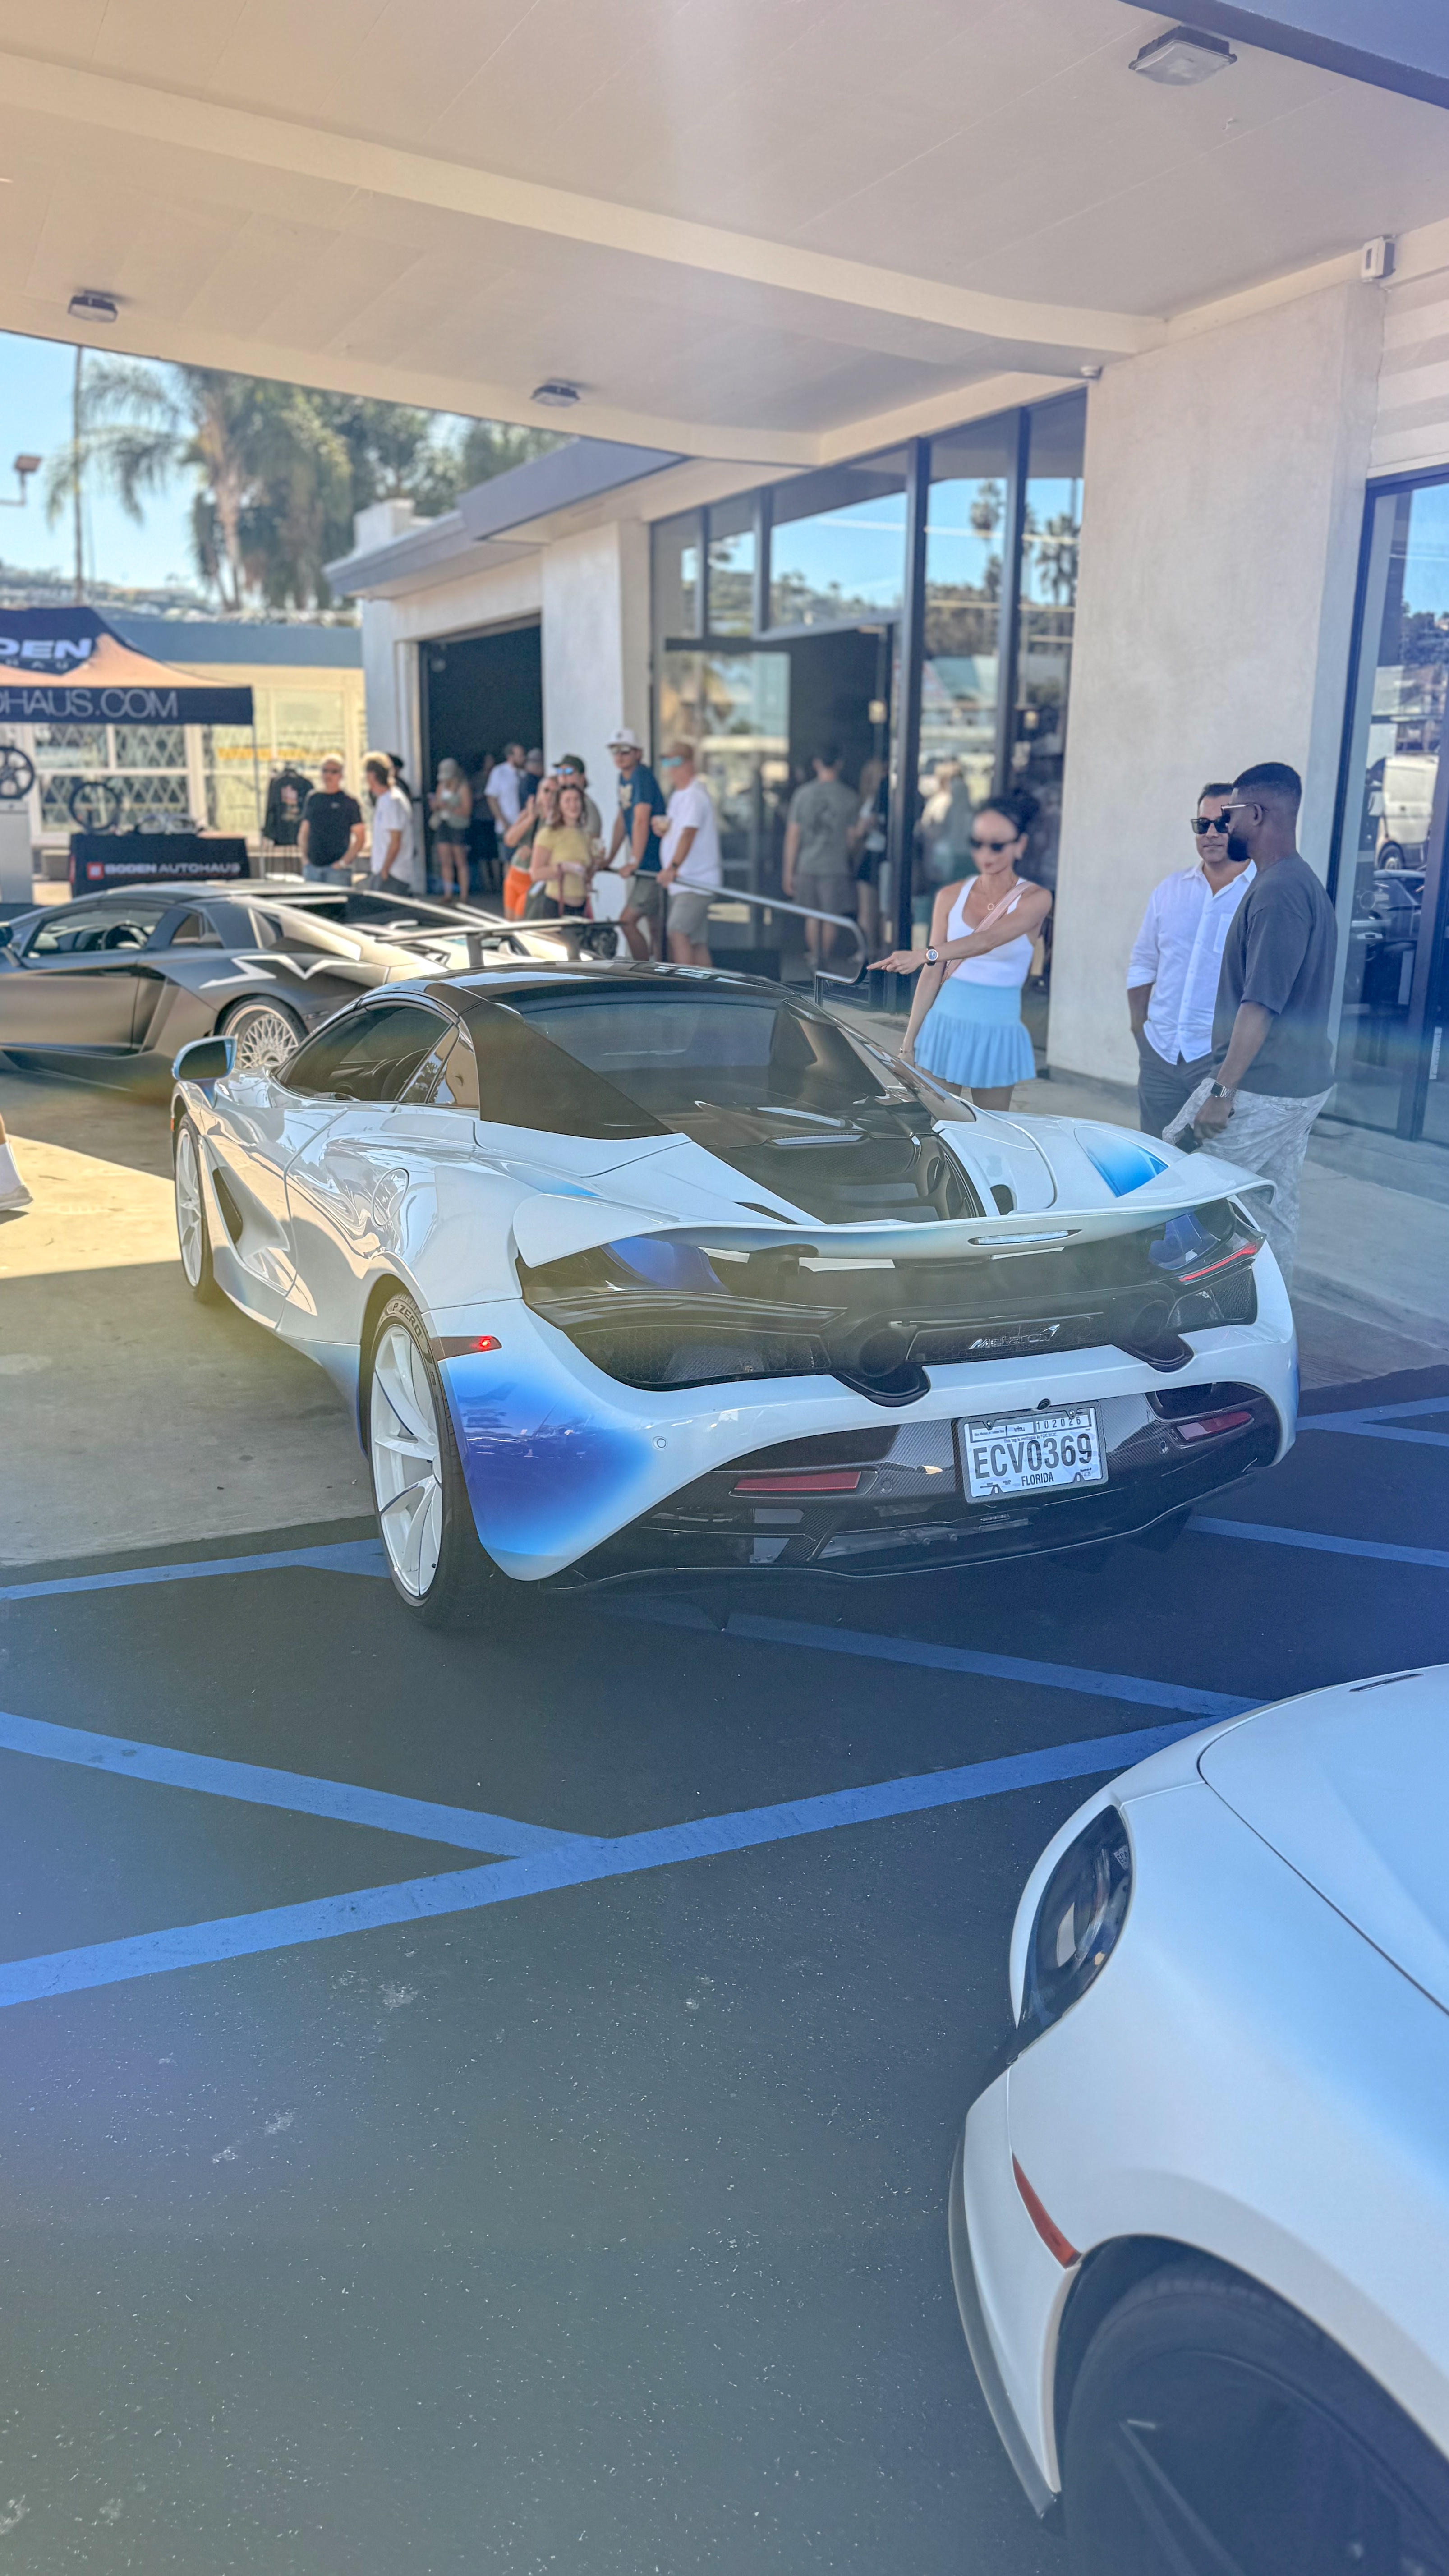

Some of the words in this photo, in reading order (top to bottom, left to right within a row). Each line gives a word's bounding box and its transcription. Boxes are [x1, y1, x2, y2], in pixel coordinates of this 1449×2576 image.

[0, 688, 178, 718] HAUS.COM
[159, 863, 241, 874] AUTOHAUS
[398, 1304, 423, 1338] ZERO
[968, 1333, 1052, 1350] McLaren
[973, 1433, 1092, 1479] ECV0369
[1021, 1472, 1054, 1487] FLORIDA
